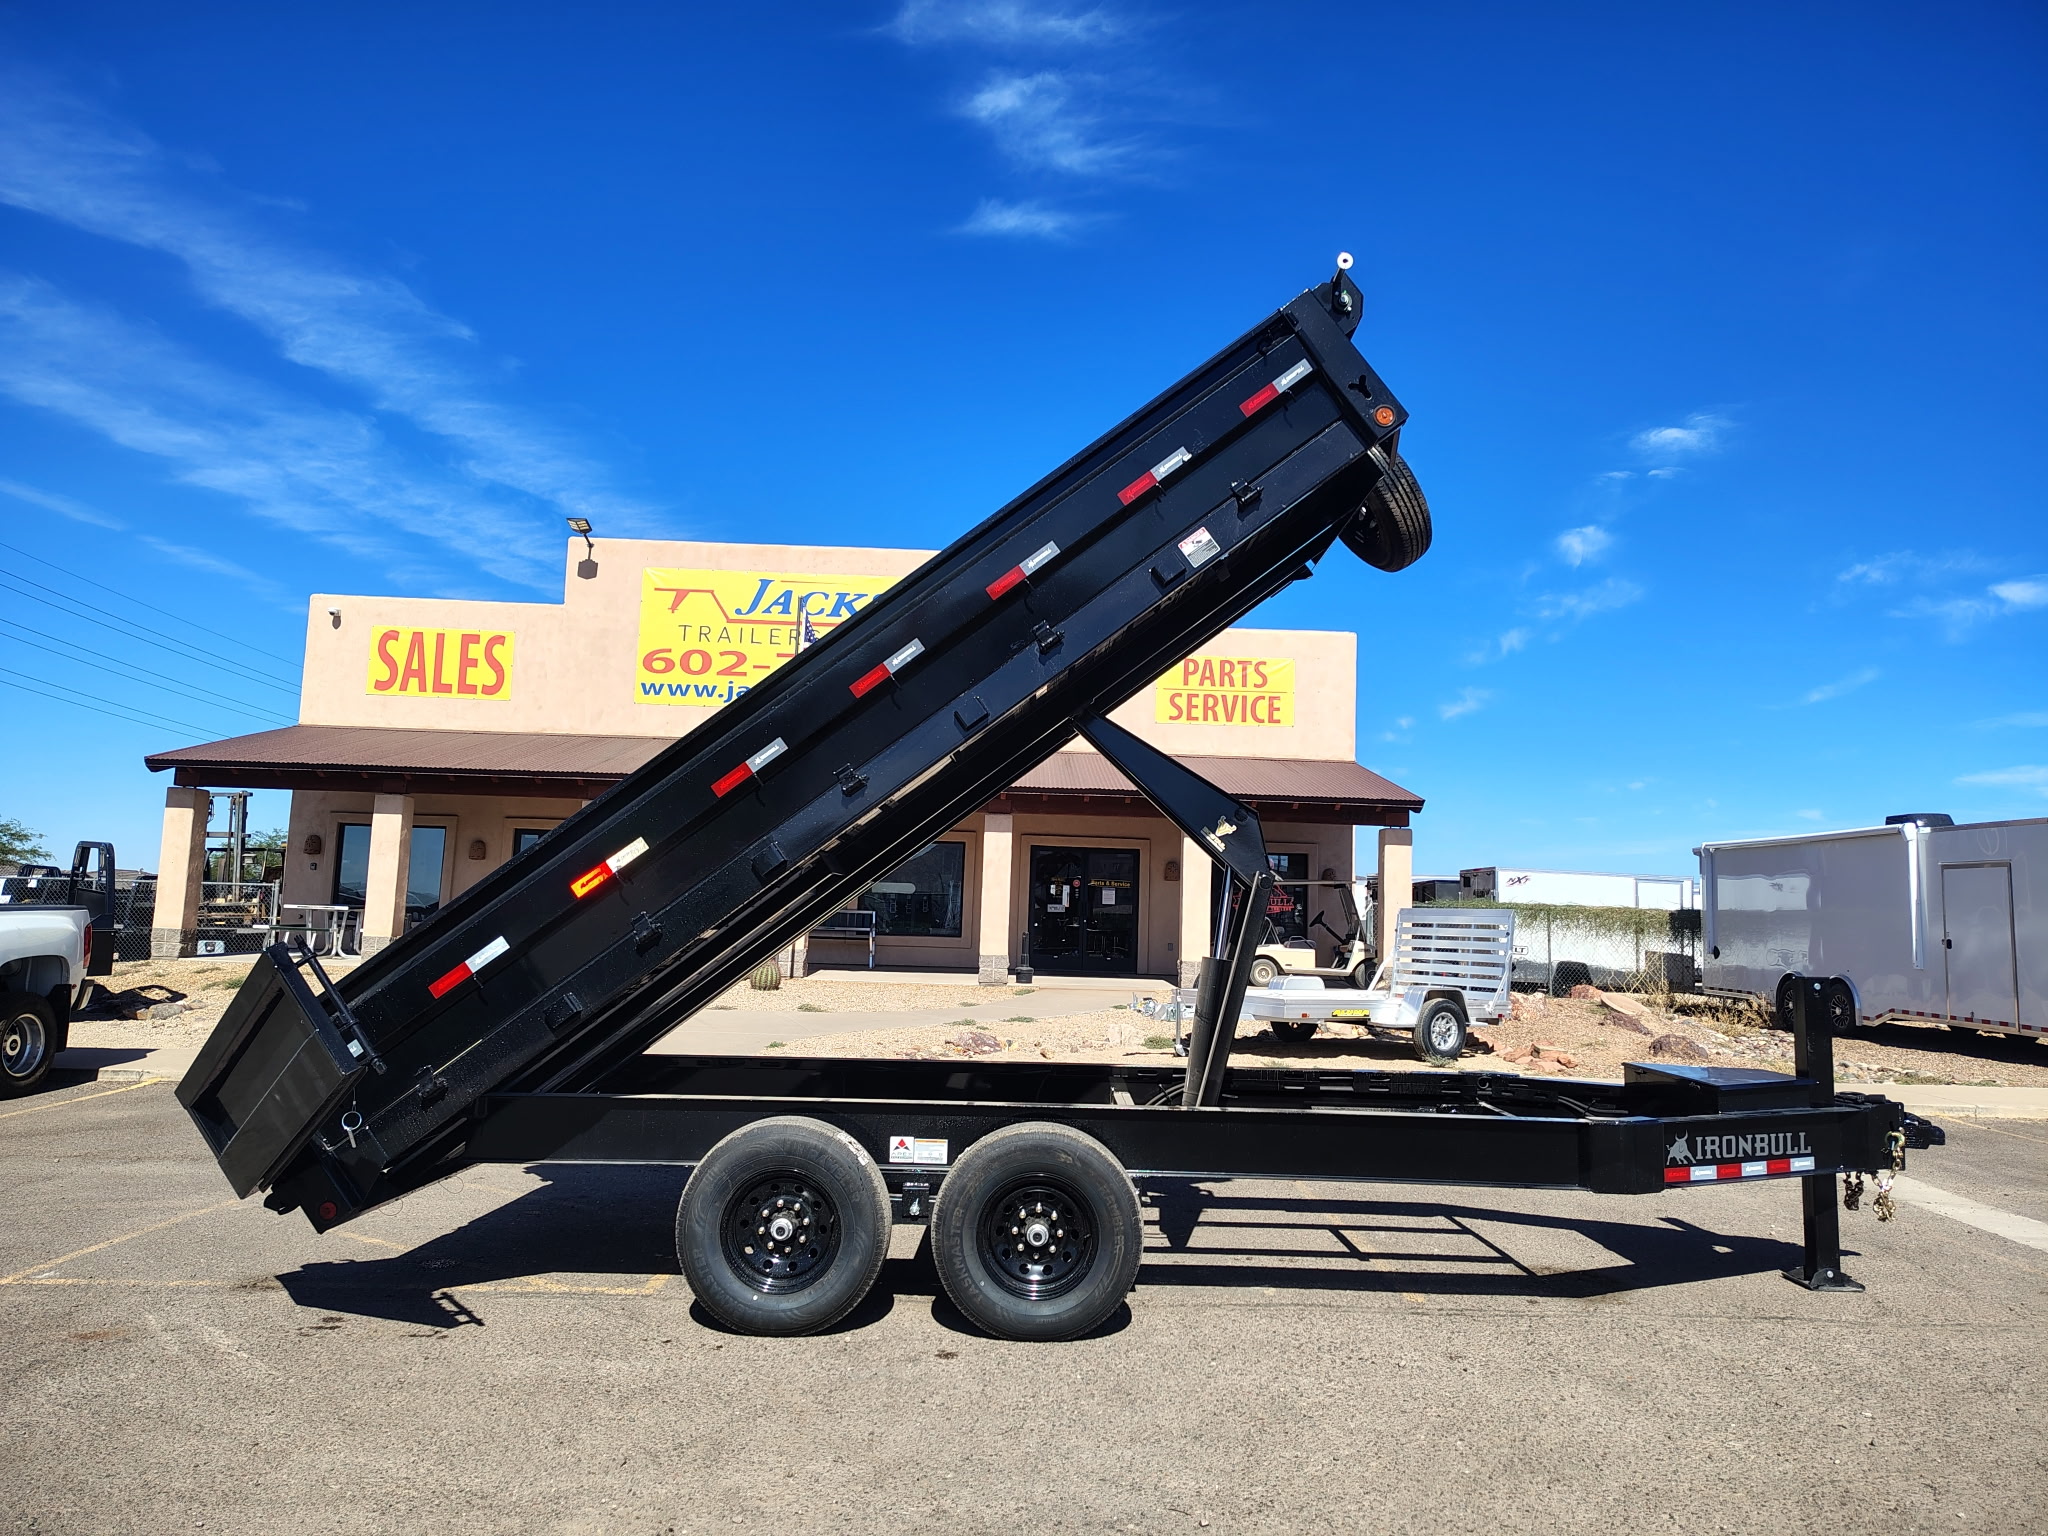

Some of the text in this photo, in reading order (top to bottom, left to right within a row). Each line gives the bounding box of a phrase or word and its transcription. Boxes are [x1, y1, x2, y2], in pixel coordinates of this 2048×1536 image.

[735, 579, 882, 618] JACK
[373, 629, 506, 696] SALES
[1183, 658, 1268, 689] PARTS
[640, 680, 751, 704] www.ja
[1168, 692, 1281, 724] SERVICE
[1695, 1131, 1812, 1160] IRONBULL
